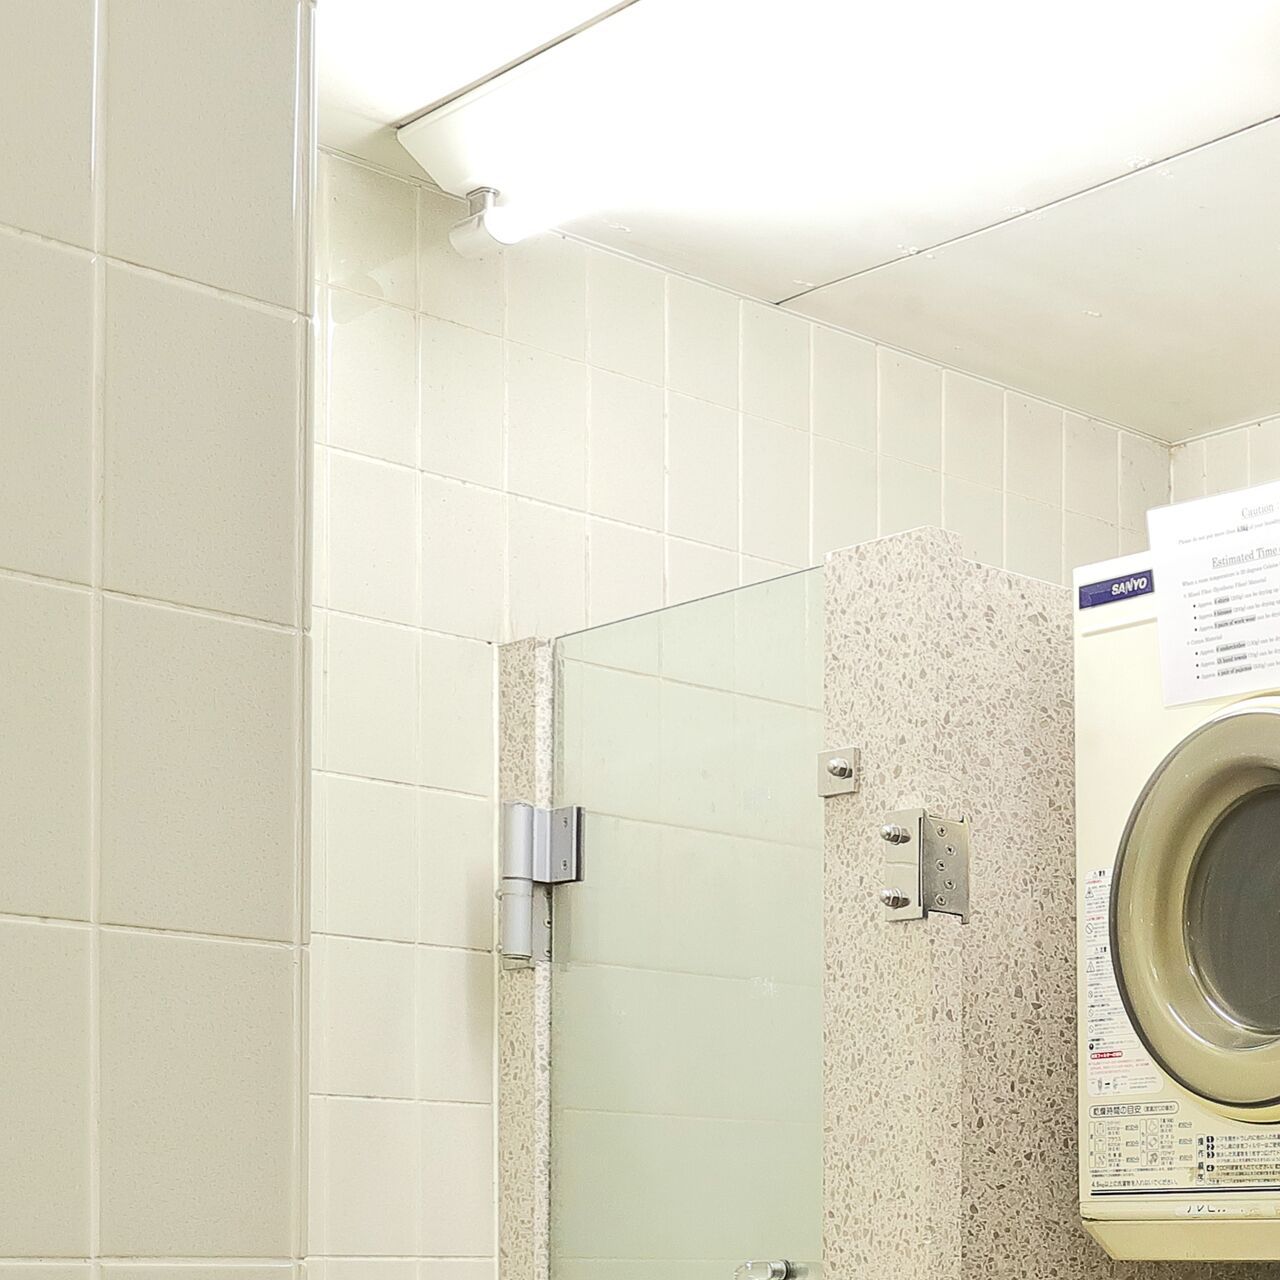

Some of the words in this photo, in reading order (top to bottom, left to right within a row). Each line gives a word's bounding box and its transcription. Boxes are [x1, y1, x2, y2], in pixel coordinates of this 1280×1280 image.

[1211, 549, 1254, 569] Estimated
[1256, 546, 1277, 559] Time
[1111, 577, 1148, 597] SANYO
